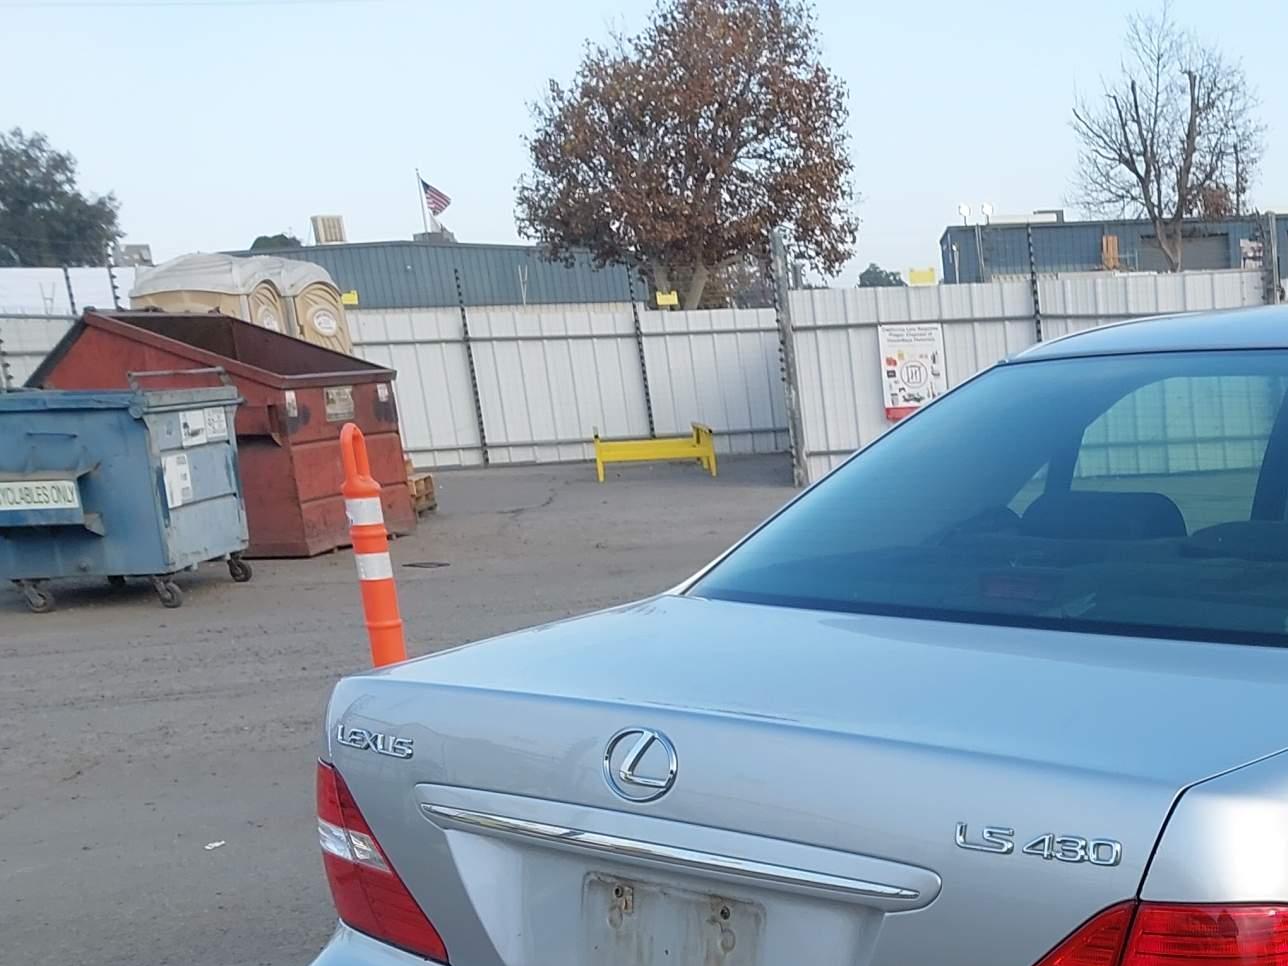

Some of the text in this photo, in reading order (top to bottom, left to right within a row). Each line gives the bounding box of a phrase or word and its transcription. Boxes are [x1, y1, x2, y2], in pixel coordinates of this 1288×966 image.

[337, 724, 414, 759] LEXUS
[955, 822, 1122, 867] LS 430
